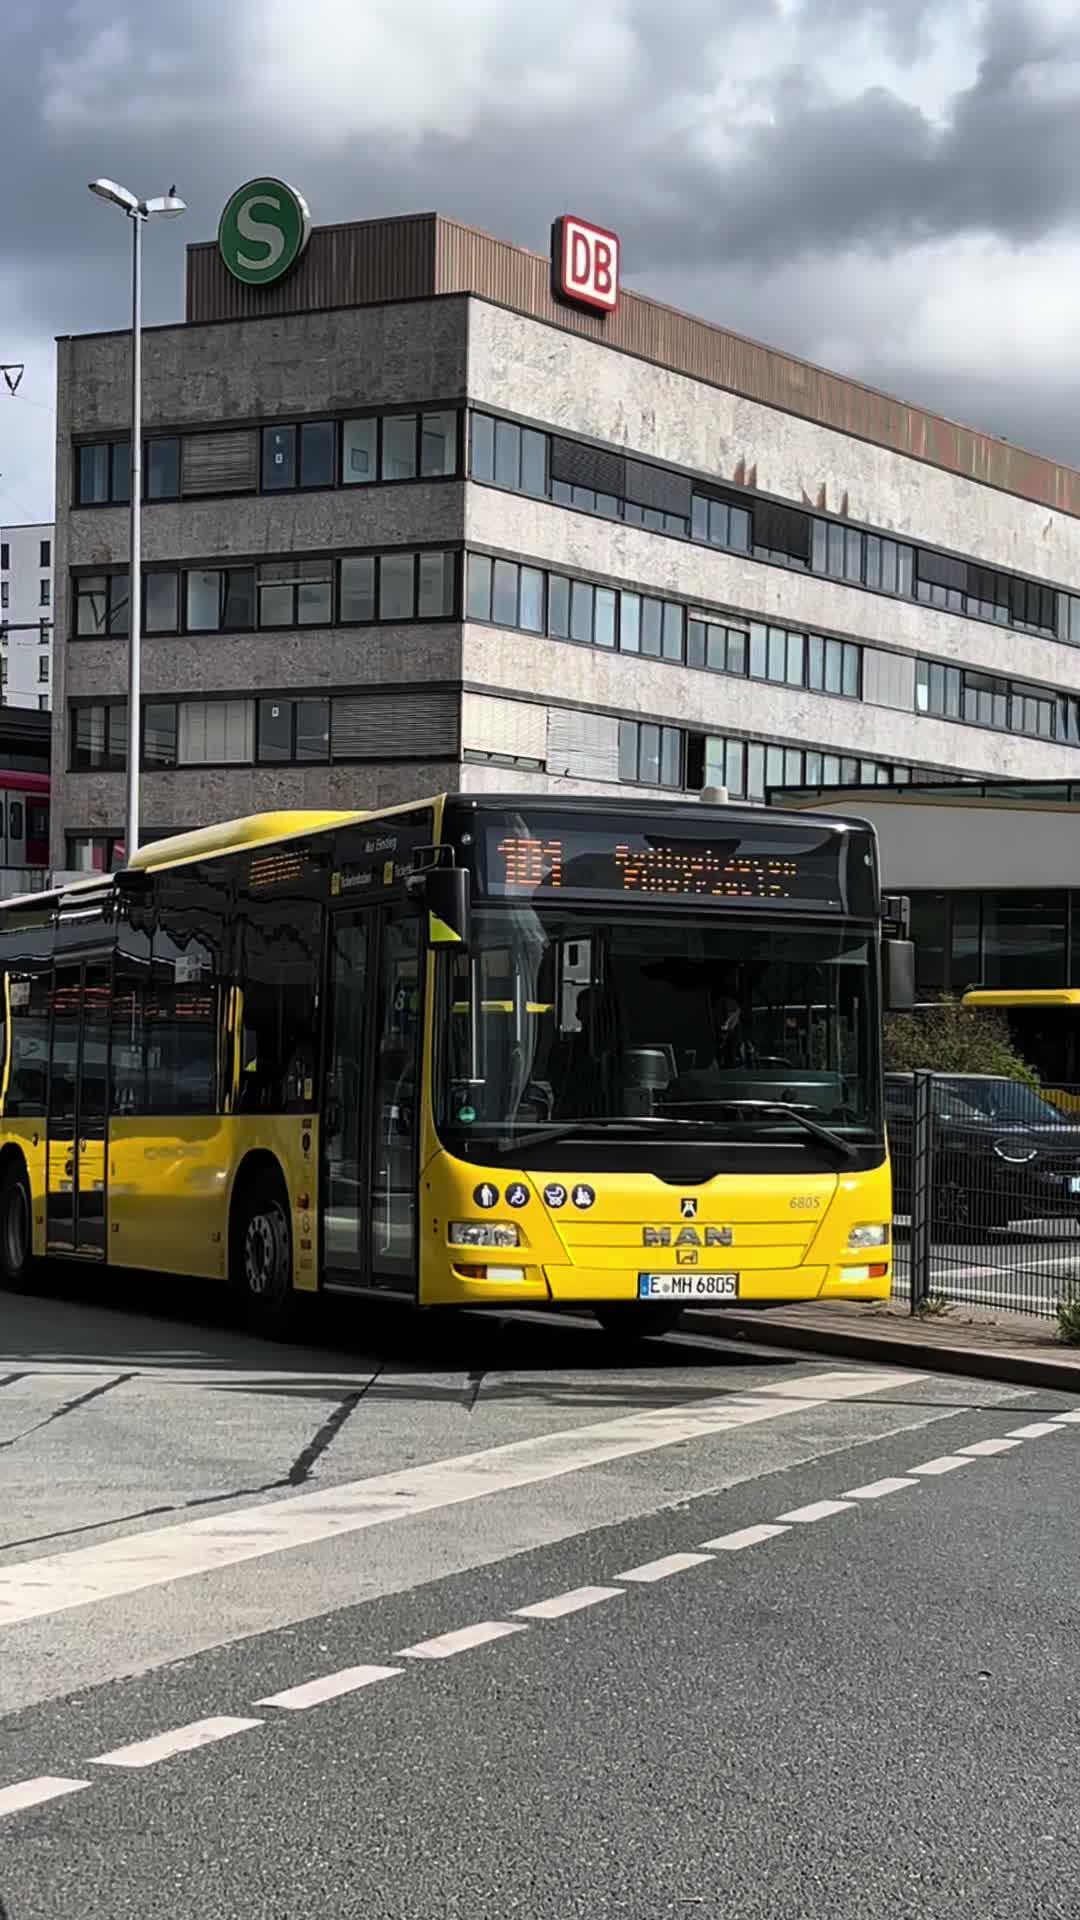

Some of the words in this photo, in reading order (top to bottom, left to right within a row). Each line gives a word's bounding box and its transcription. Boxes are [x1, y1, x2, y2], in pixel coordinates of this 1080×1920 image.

[236, 194, 285, 271] S
[571, 229, 612, 294] DB
[789, 1195, 821, 1209] 6805
[642, 1226, 733, 1248] MAN
[696, 1276, 735, 1294] 6805
